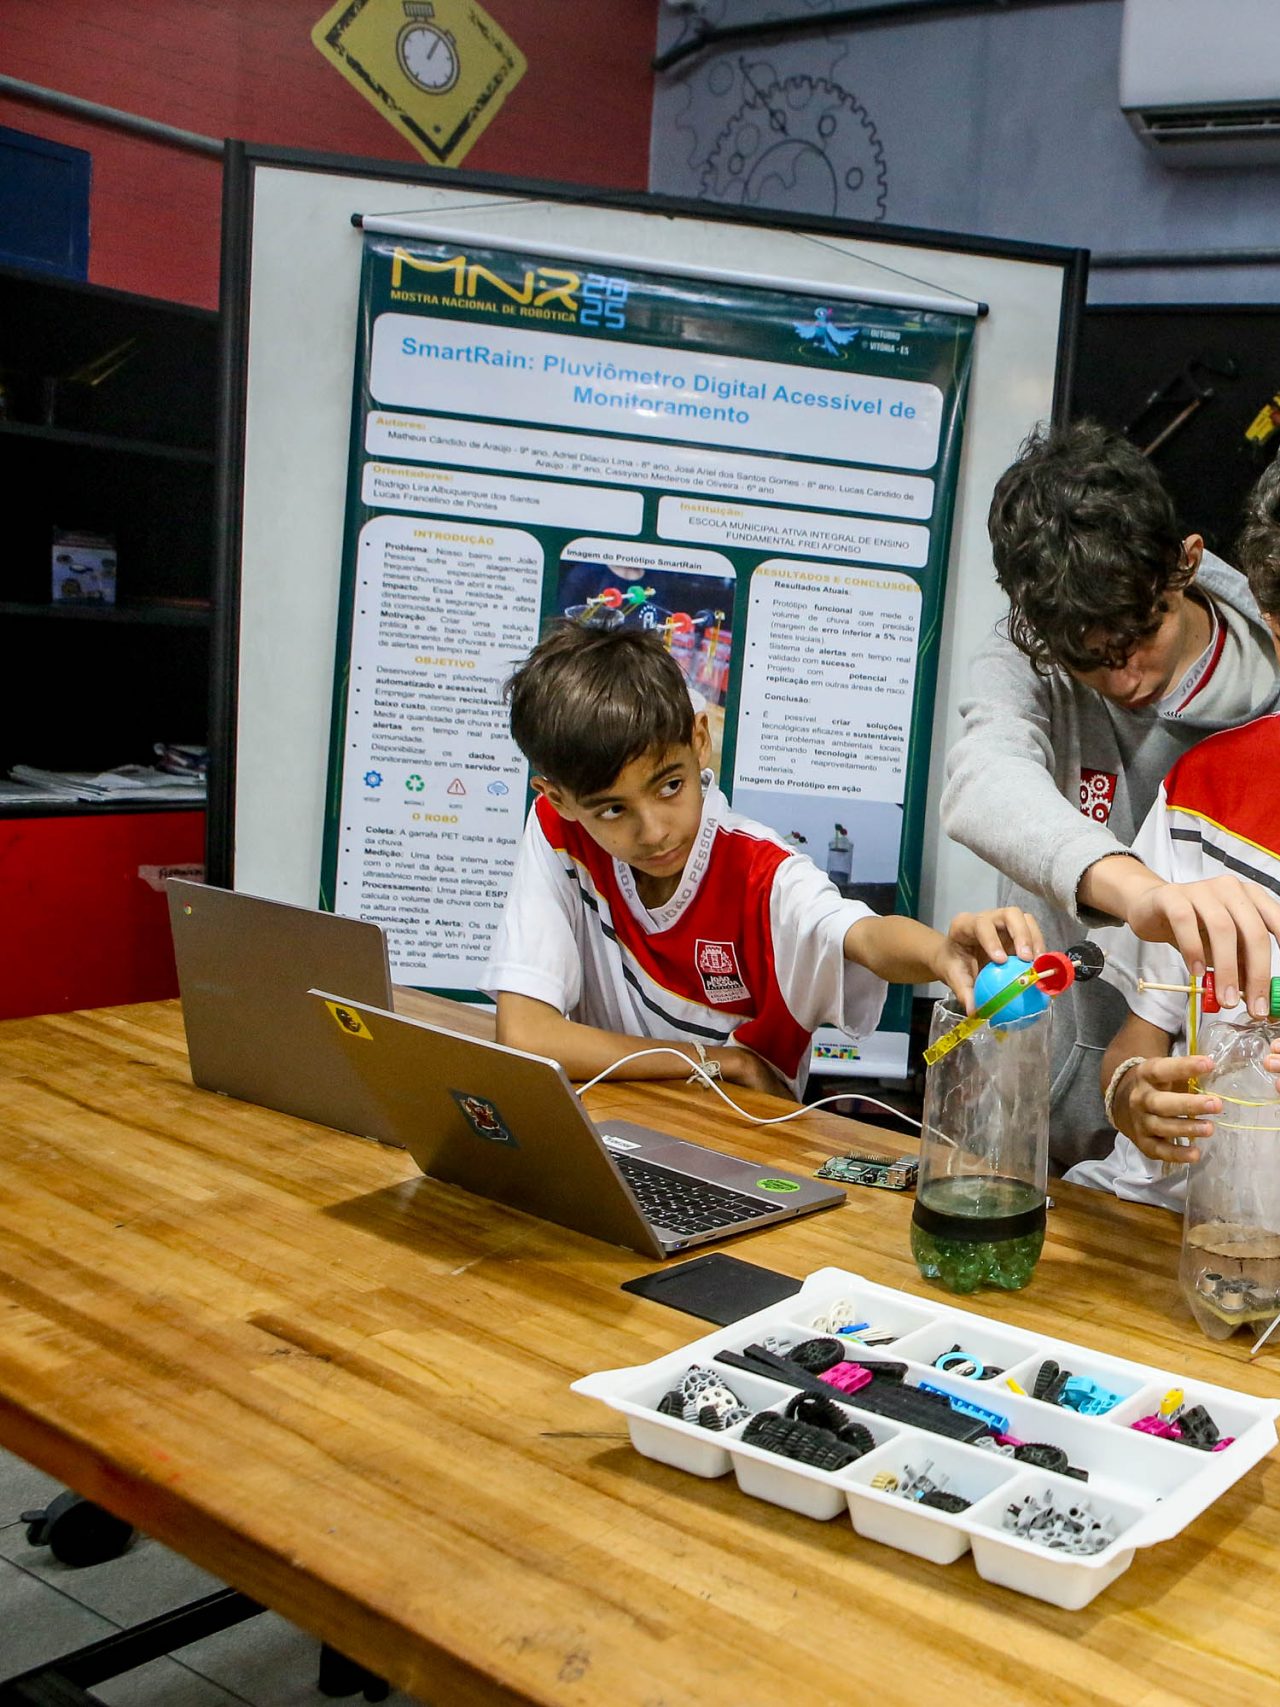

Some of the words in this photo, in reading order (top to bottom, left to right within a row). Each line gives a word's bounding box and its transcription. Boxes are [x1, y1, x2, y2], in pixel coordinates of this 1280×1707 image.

[391, 246, 581, 311] MNR
[390, 290, 439, 305] MOSTRA
[442, 296, 498, 313] NACIONAL
[502, 305, 516, 315] DE
[401, 337, 534, 371] SmartRain:
[543, 354, 685, 390] Pluviômetro
[693, 374, 766, 399] Digital
[772, 384, 882, 415] Acessível
[889, 400, 916, 419] de
[573, 385, 750, 425] Monitoramento
[388, 430, 427, 442] Matheus
[483, 441, 512, 453] Araújo
[553, 449, 578, 460] Adriel
[612, 456, 634, 467] Lima
[675, 464, 696, 474] José
[697, 466, 717, 477] Ariel
[719, 469, 735, 479] dos
[737, 471, 767, 482] Santos
[769, 475, 800, 486] Gomes
[839, 483, 865, 494] Lucas
[374, 478, 411, 491] Rodrigo
[413, 482, 430, 492] Lira
[431, 485, 489, 499] Albuquerque
[491, 491, 508, 500] dos
[510, 493, 541, 504] Santos
[373, 489, 401, 499] Lucas
[403, 492, 451, 505] Francelino
[467, 499, 498, 510] Pontes
[414, 530, 495, 545] INTRODUÇÃO
[689, 518, 728, 528] ESCOLA
[729, 522, 780, 534] MUNICIPAL
[782, 528, 808, 537] ATIVA
[810, 530, 856, 542] INTEGRAL
[858, 536, 872, 544] DE
[874, 537, 910, 548] ENSINO
[726, 532, 796, 546] FUNDAMENTAL
[799, 540, 820, 549] FREI
[822, 542, 862, 553] AFONSO
[567, 549, 601, 559] Imagem
[603, 552, 614, 560] do
[616, 553, 656, 565] Protótipo
[658, 557, 702, 568] SmartRain
[755, 567, 831, 583] RESULTADOS
[833, 575, 842, 584] E
[775, 581, 821, 592] Resultados
[823, 585, 849, 594] Atuais
[381, 610, 426, 621] Motivação
[773, 599, 808, 610] Protótipo
[815, 603, 853, 614] funcional
[880, 611, 902, 619] mede
[843, 628, 872, 637] inferior
[819, 648, 847, 656] alertas
[415, 656, 476, 668] OBJETIVO
[376, 678, 436, 688] automatizado
[767, 676, 810, 685] replicação
[849, 672, 888, 682] potencial
[373, 721, 403, 730] alertas
[762, 722, 810, 733] tecnológicas
[853, 731, 905, 741] sustentáveis
[867, 722, 903, 731] soluções
[469, 751, 496, 760] dados
[815, 748, 858, 759] tecnologia
[465, 763, 501, 771] servidor
[740, 775, 773, 785] Imagem
[787, 779, 826, 790] Protótipo
[842, 784, 862, 793] ação
[688, 817, 717, 884] PESSOA
[359, 913, 421, 925] Comunicação
